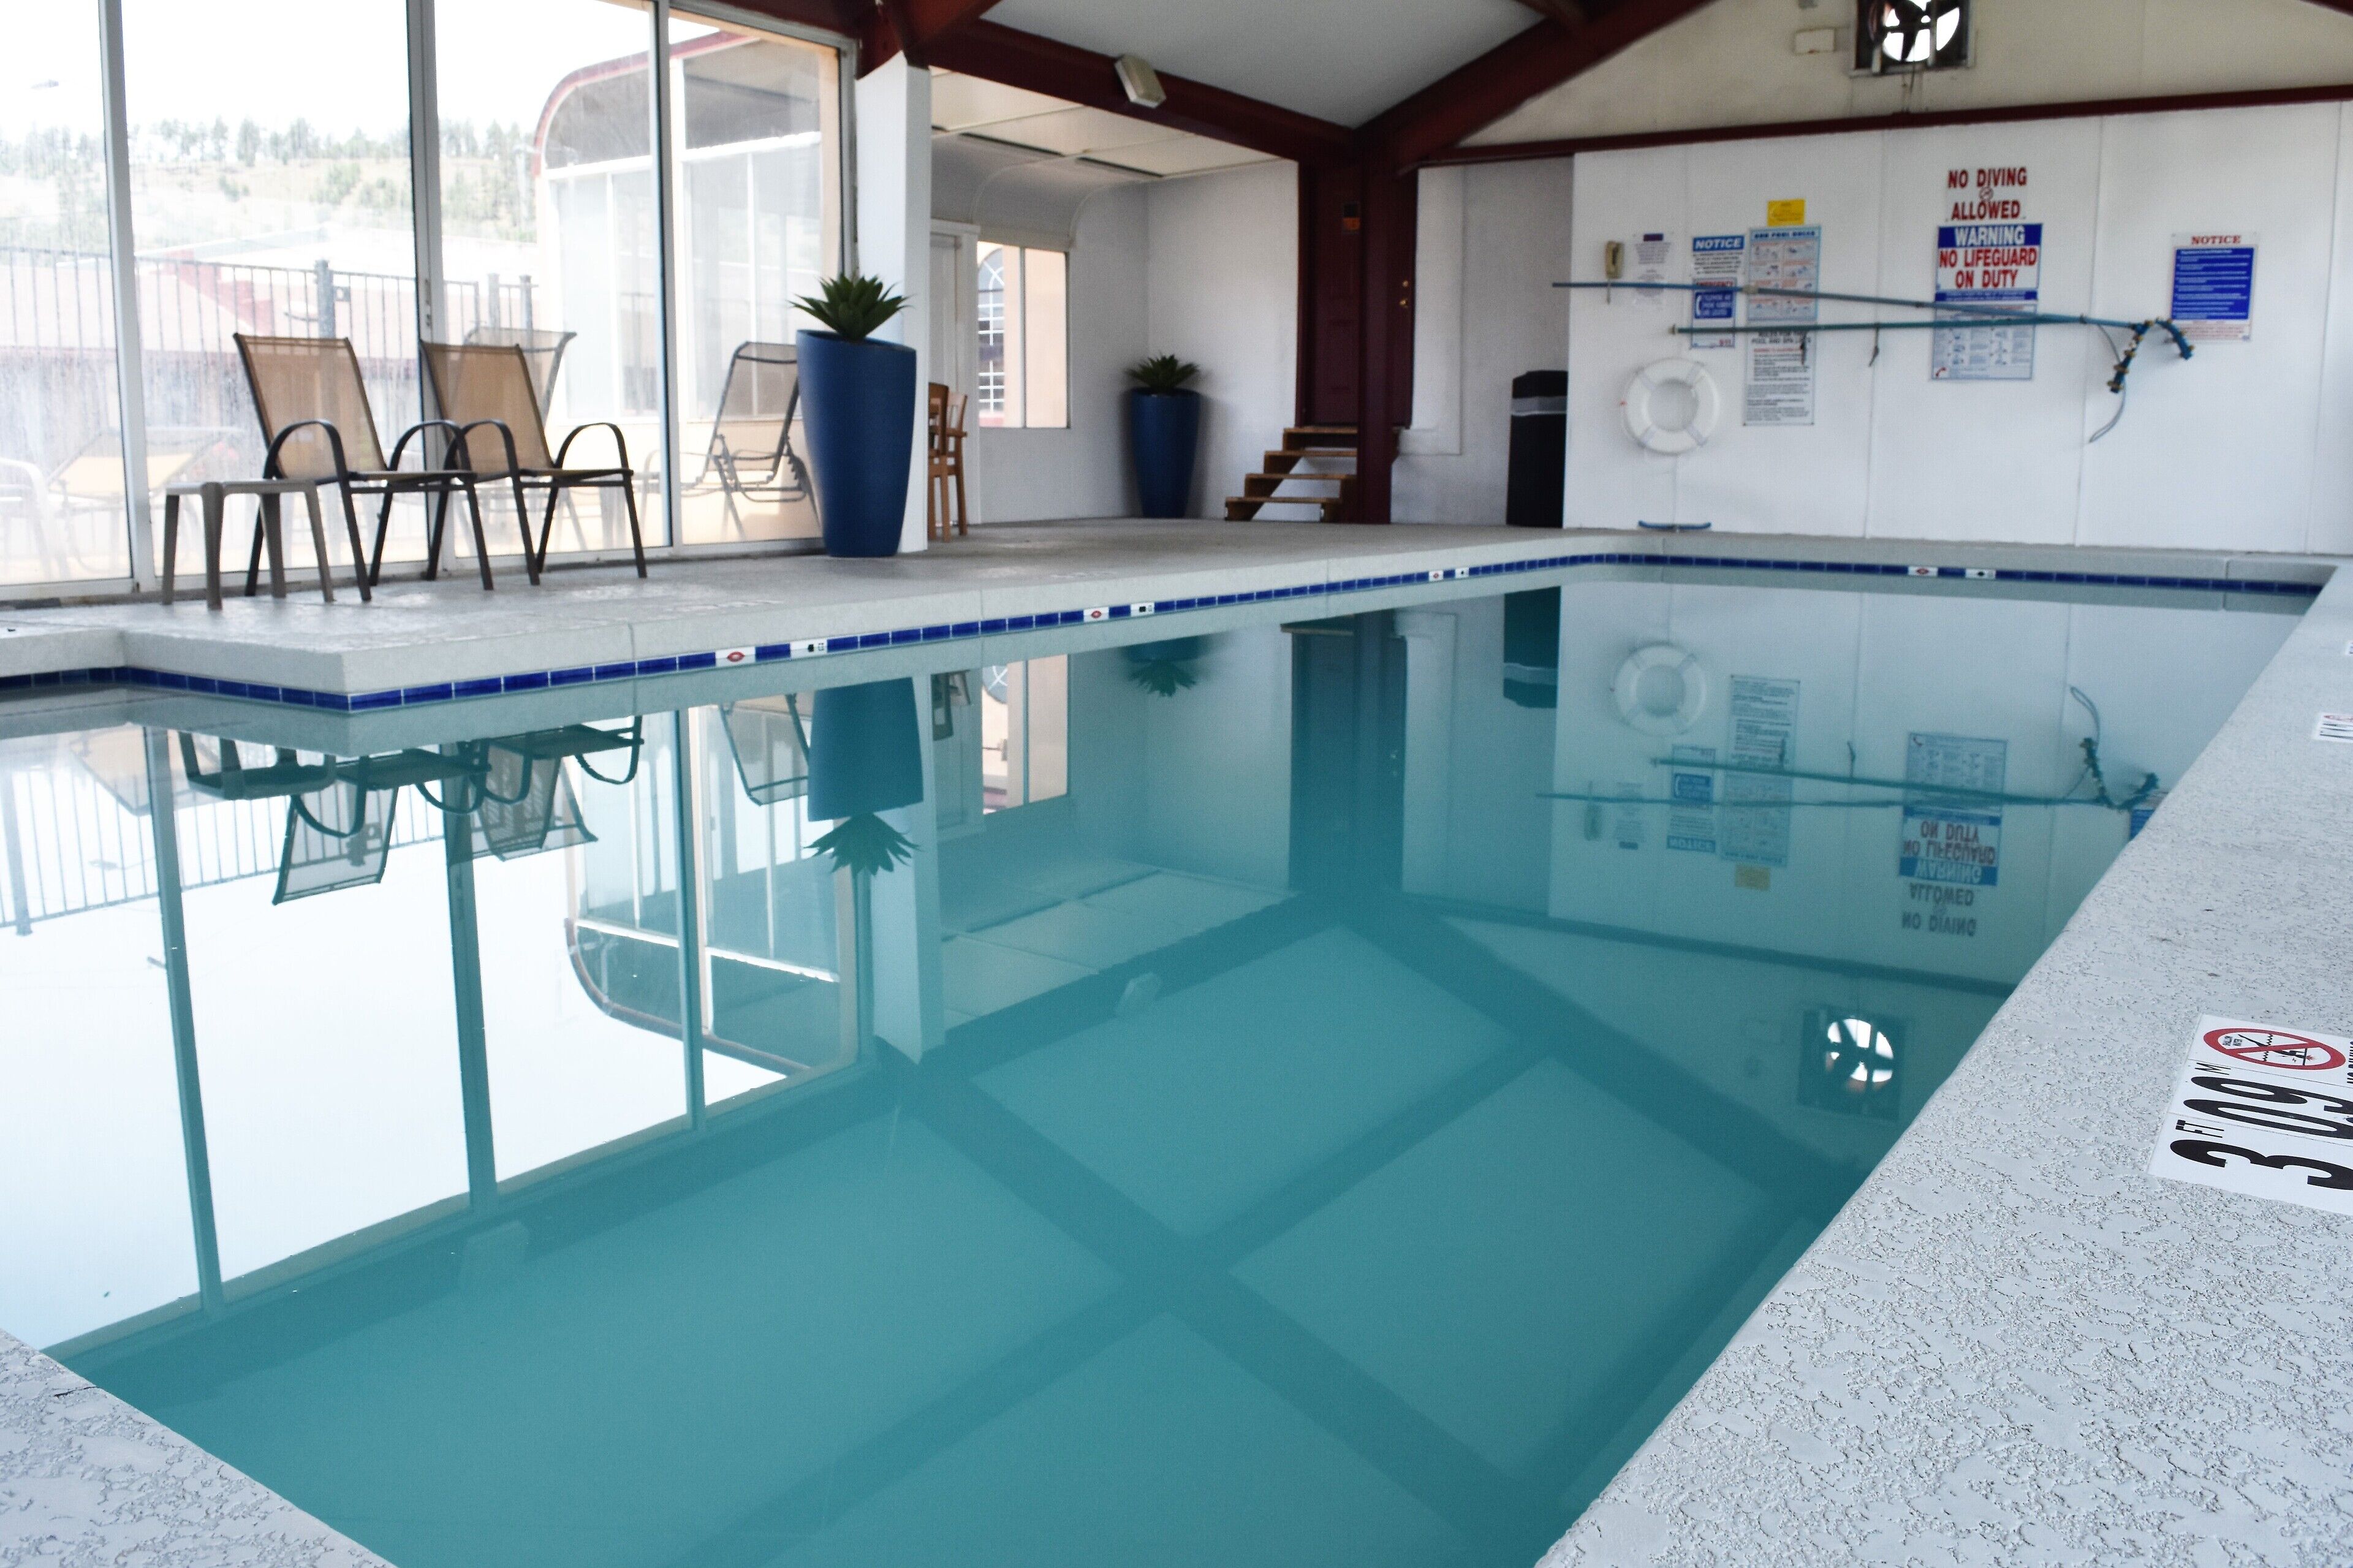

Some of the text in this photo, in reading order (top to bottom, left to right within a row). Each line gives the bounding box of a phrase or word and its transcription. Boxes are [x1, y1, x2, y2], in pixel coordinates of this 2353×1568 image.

[1948, 167, 2027, 188] NO DIVING
[1951, 199, 2021, 221] ALLOWED
[1695, 237, 1741, 249] NOTICE
[1955, 225, 2026, 247] WARNING
[2191, 235, 2241, 245] NOTICE
[1939, 247, 2037, 268] NO LIFEGUARD
[1955, 269, 2019, 289] ON DUTY
[2194, 1062, 2232, 1075] M
[2170, 1119, 2353, 1191] 3 FT
